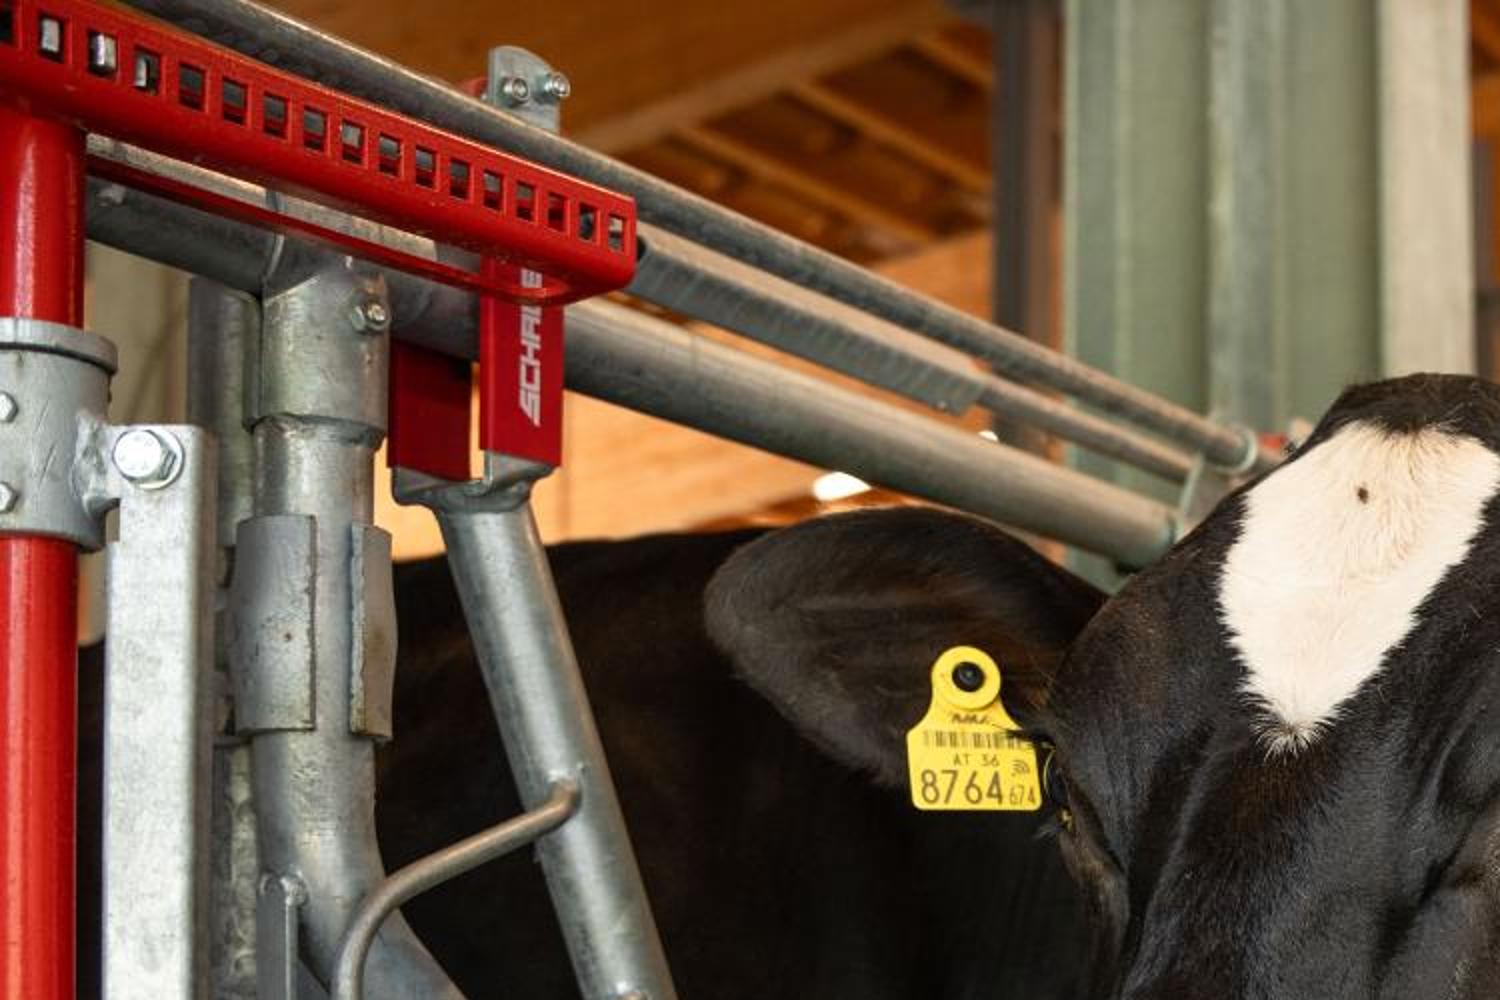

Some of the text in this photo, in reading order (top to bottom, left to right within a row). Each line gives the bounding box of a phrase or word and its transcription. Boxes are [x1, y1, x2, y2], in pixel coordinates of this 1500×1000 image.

[953, 753, 971, 767] AT
[921, 769, 1036, 806] 8764 674
